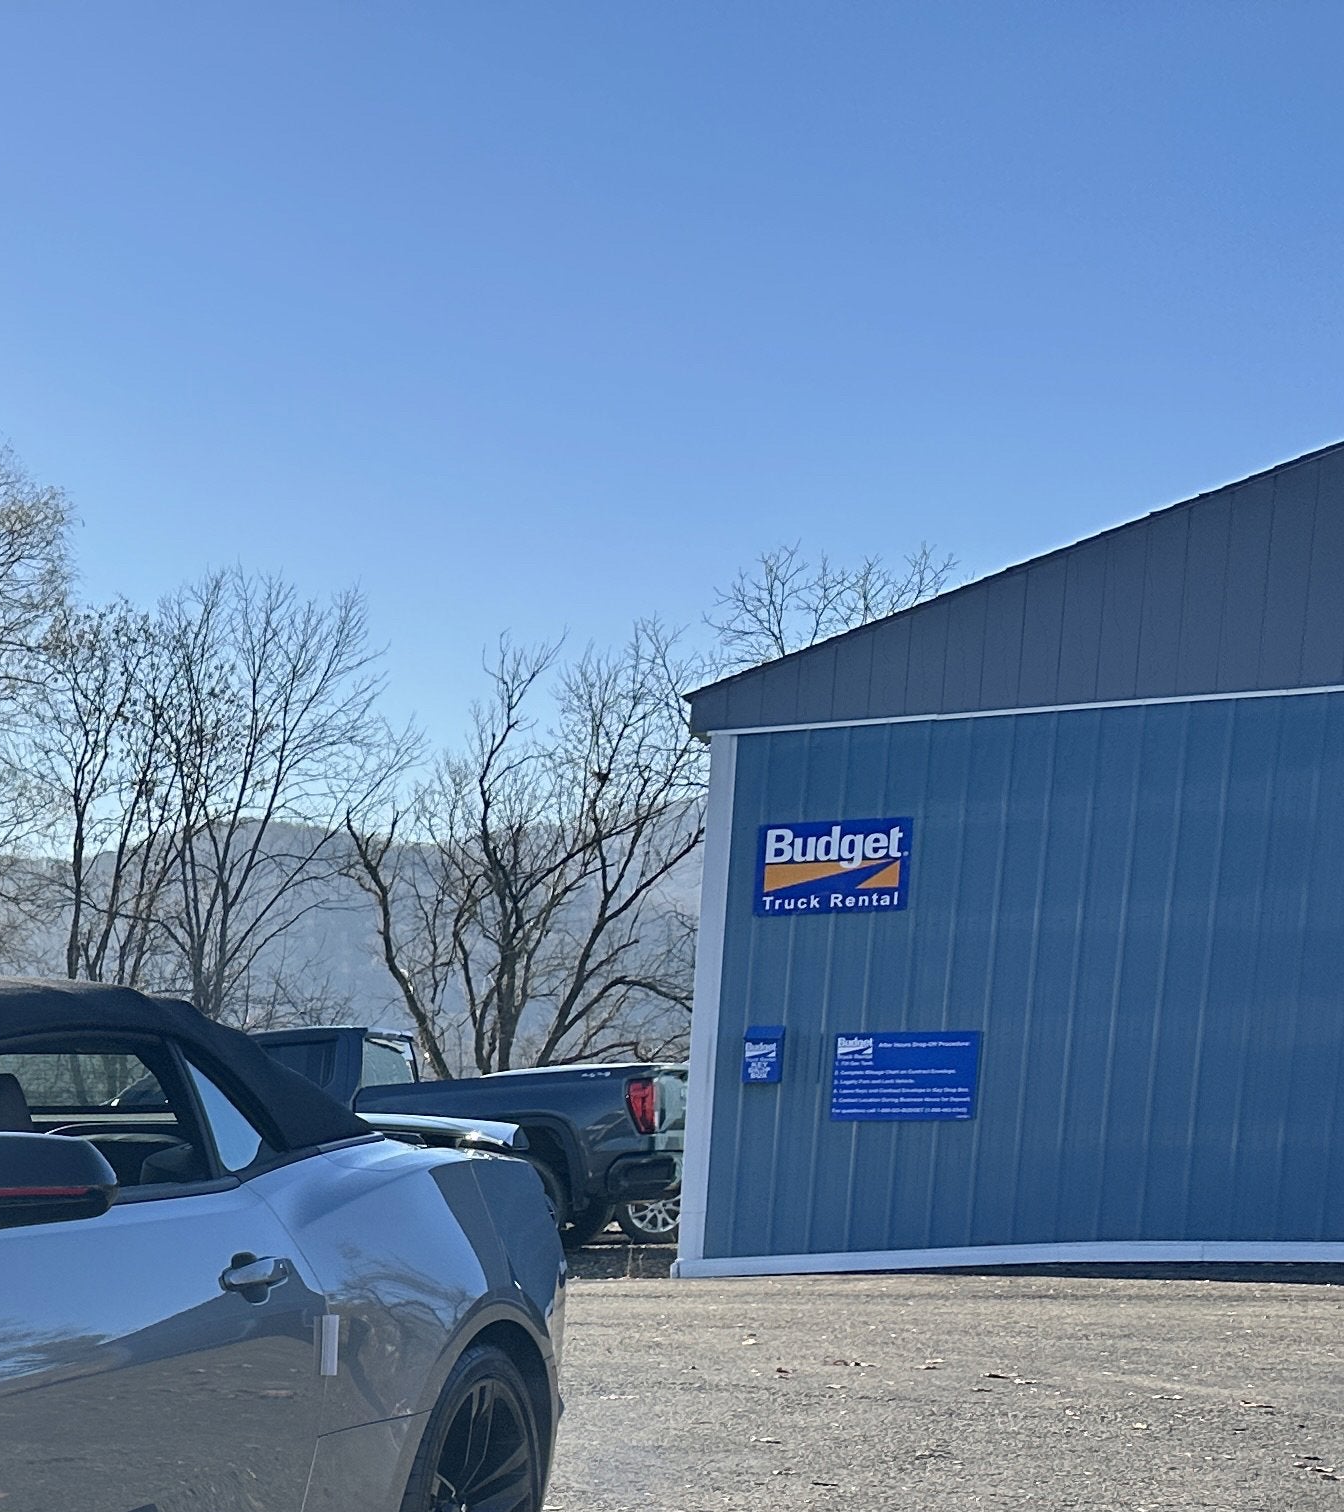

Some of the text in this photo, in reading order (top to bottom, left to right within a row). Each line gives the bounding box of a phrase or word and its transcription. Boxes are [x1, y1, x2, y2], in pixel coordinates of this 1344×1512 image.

[765, 825, 904, 868] Budget
[762, 892, 899, 910] Truck Rental
